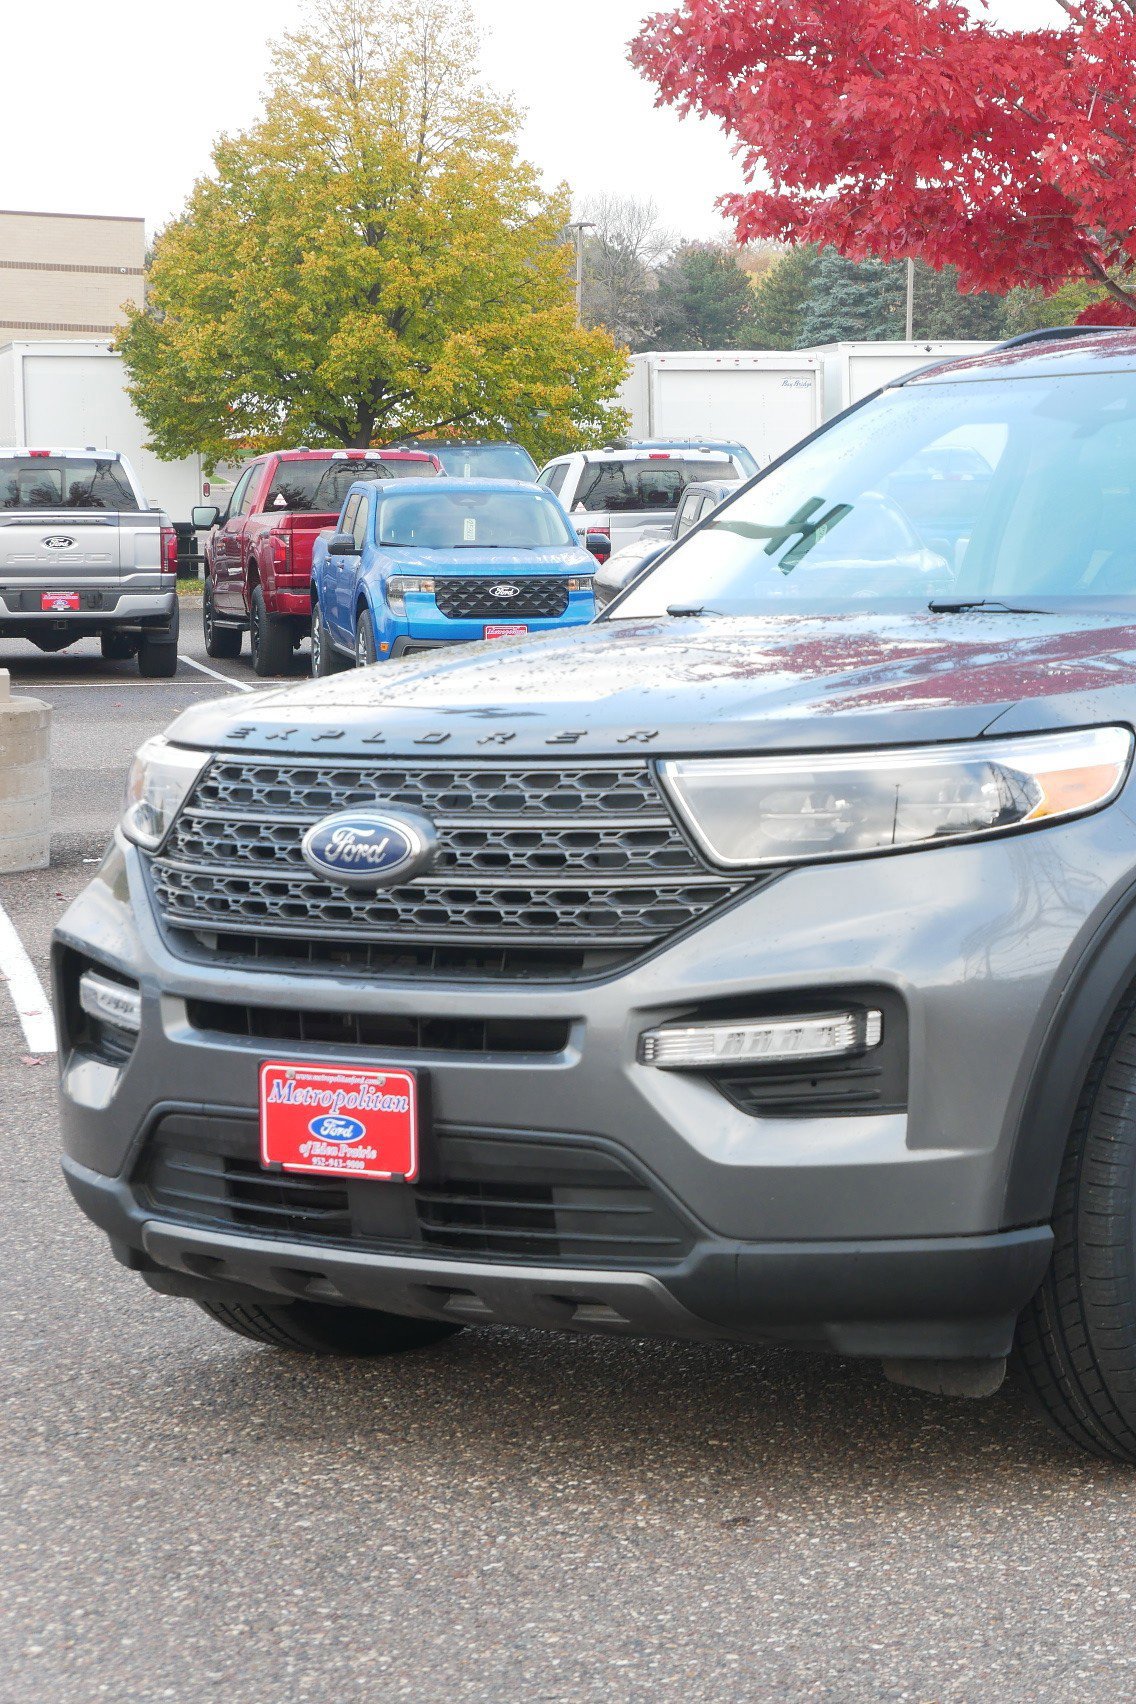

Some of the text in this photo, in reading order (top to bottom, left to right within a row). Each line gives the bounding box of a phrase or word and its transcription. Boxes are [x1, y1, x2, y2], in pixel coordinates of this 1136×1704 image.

[6, 553, 112, 564] F-150
[494, 587, 514, 596] Ford
[226, 727, 659, 745] EXPLORER
[324, 826, 390, 865] Ford
[267, 1079, 409, 1115] Metropolitan
[320, 1118, 354, 1138] Ford
